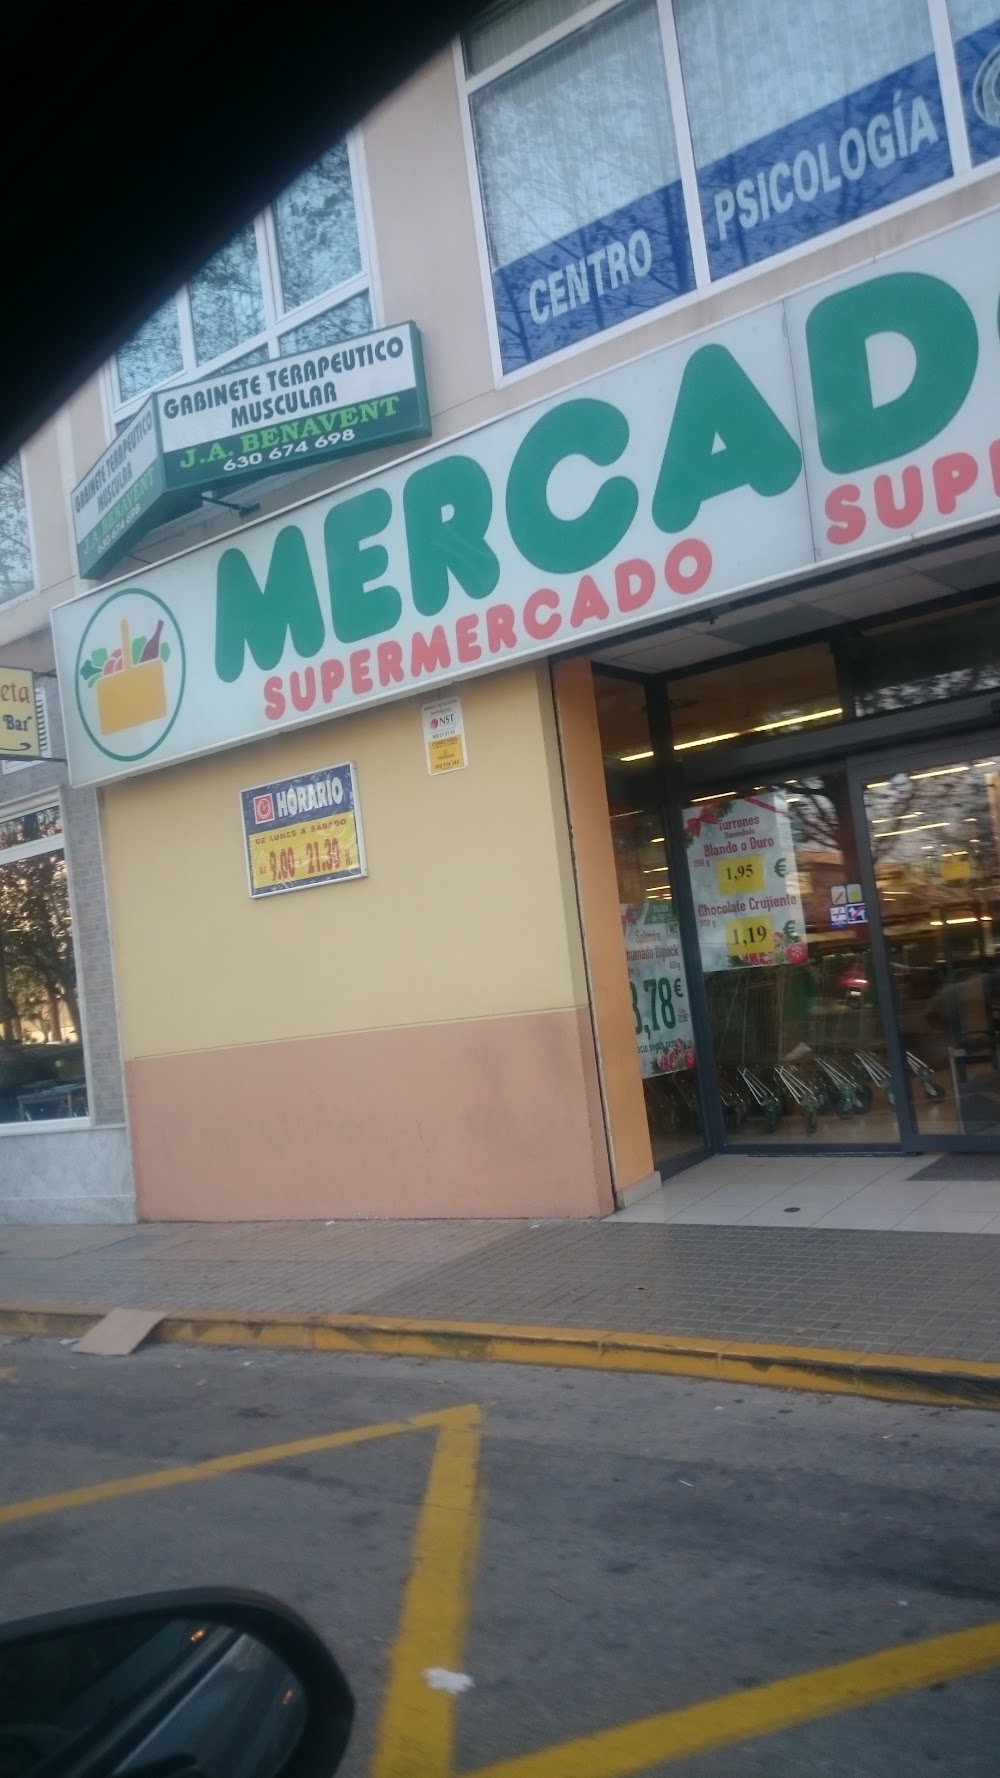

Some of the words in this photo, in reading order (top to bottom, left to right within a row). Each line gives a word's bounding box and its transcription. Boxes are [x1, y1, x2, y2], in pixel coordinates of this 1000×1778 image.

[714, 90, 939, 241] PSICOLOGÍA
[528, 230, 652, 326] CENTRO
[163, 375, 261, 419] GABINETE
[266, 337, 404, 391] TERAPEUTICO
[231, 381, 337, 428] MUSCULAR
[180, 442, 234, 468] J.A.
[241, 395, 400, 453] BENAVENT
[223, 452, 262, 471] 630
[268, 440, 308, 460] 674
[314, 428, 355, 449] 698
[75, 464, 107, 514] GABINETE
[105, 411, 152, 478] TERAPEUTICO
[214, 271, 1000, 683] MERCAD
[97, 461, 133, 515] MUSCULAR
[264, 538, 713, 720] SUPERMERCADO
[3, 714, 32, 732] Bar
[439, 713, 455, 726] NST
[276, 777, 343, 818] HORARIO
[255, 837, 266, 845] DE
[270, 831, 297, 842] LUNES
[310, 818, 347, 833] SABADO
[718, 816, 760, 832] Turrones
[269, 846, 296, 881] 9.00
[704, 843, 738, 858] Blando
[742, 842, 747, 851] o
[750, 836, 775, 850] Duro
[725, 864, 754, 881] 1,95
[774, 857, 787, 878] €
[698, 903, 746, 917] Chocolate
[750, 895, 797, 912] Crujiente
[732, 925, 767, 947] 1,19
[783, 919, 799, 940] €
[673, 978, 683, 997] €
